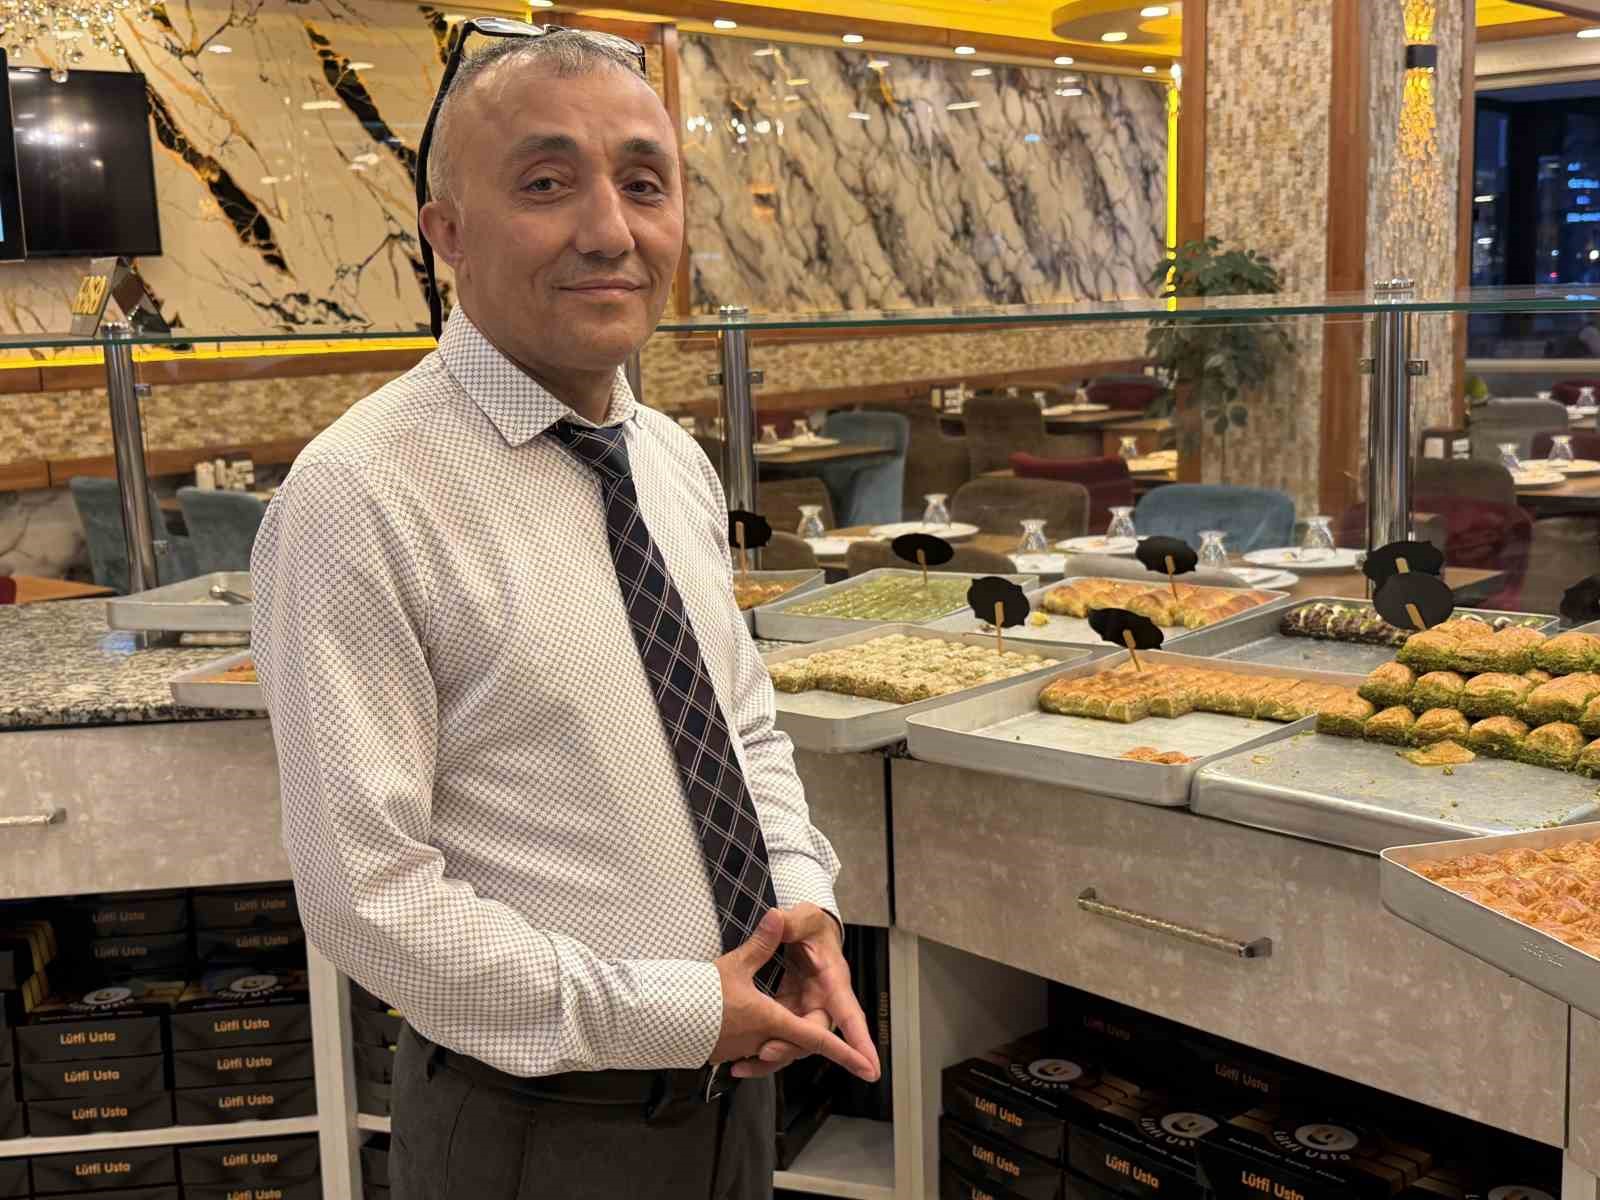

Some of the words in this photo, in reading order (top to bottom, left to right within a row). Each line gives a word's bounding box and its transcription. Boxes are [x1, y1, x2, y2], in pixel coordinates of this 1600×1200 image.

[214, 1019, 241, 1032] Lütfi
[243, 1017, 270, 1030] Usta
[60, 1032, 87, 1046] Lütfi
[89, 1031, 116, 1043] Usta
[217, 1057, 244, 1071] Lütfi
[245, 1056, 272, 1068] Usta
[64, 1070, 91, 1084] Lütfi
[92, 1069, 120, 1081] Usta
[219, 1095, 245, 1109] Lütfi
[246, 1094, 274, 1106] Usta
[72, 1107, 98, 1121] Lütfi
[100, 1105, 129, 1118] Usta
[975, 1096, 998, 1116] Lütfi
[999, 1106, 1025, 1128] Usta
[223, 1153, 249, 1167] Lütfi
[251, 1152, 279, 1165] Usta
[971, 1144, 995, 1165] Lütfi
[996, 1155, 1021, 1177] Usta
[75, 1163, 102, 1177] Lütfi
[104, 1161, 131, 1174] Usta
[1105, 1153, 1132, 1177] Lütfi
[1132, 1167, 1160, 1190] Usta
[1241, 1169, 1270, 1193] Lütfi
[255, 1188, 282, 1200] Usta
